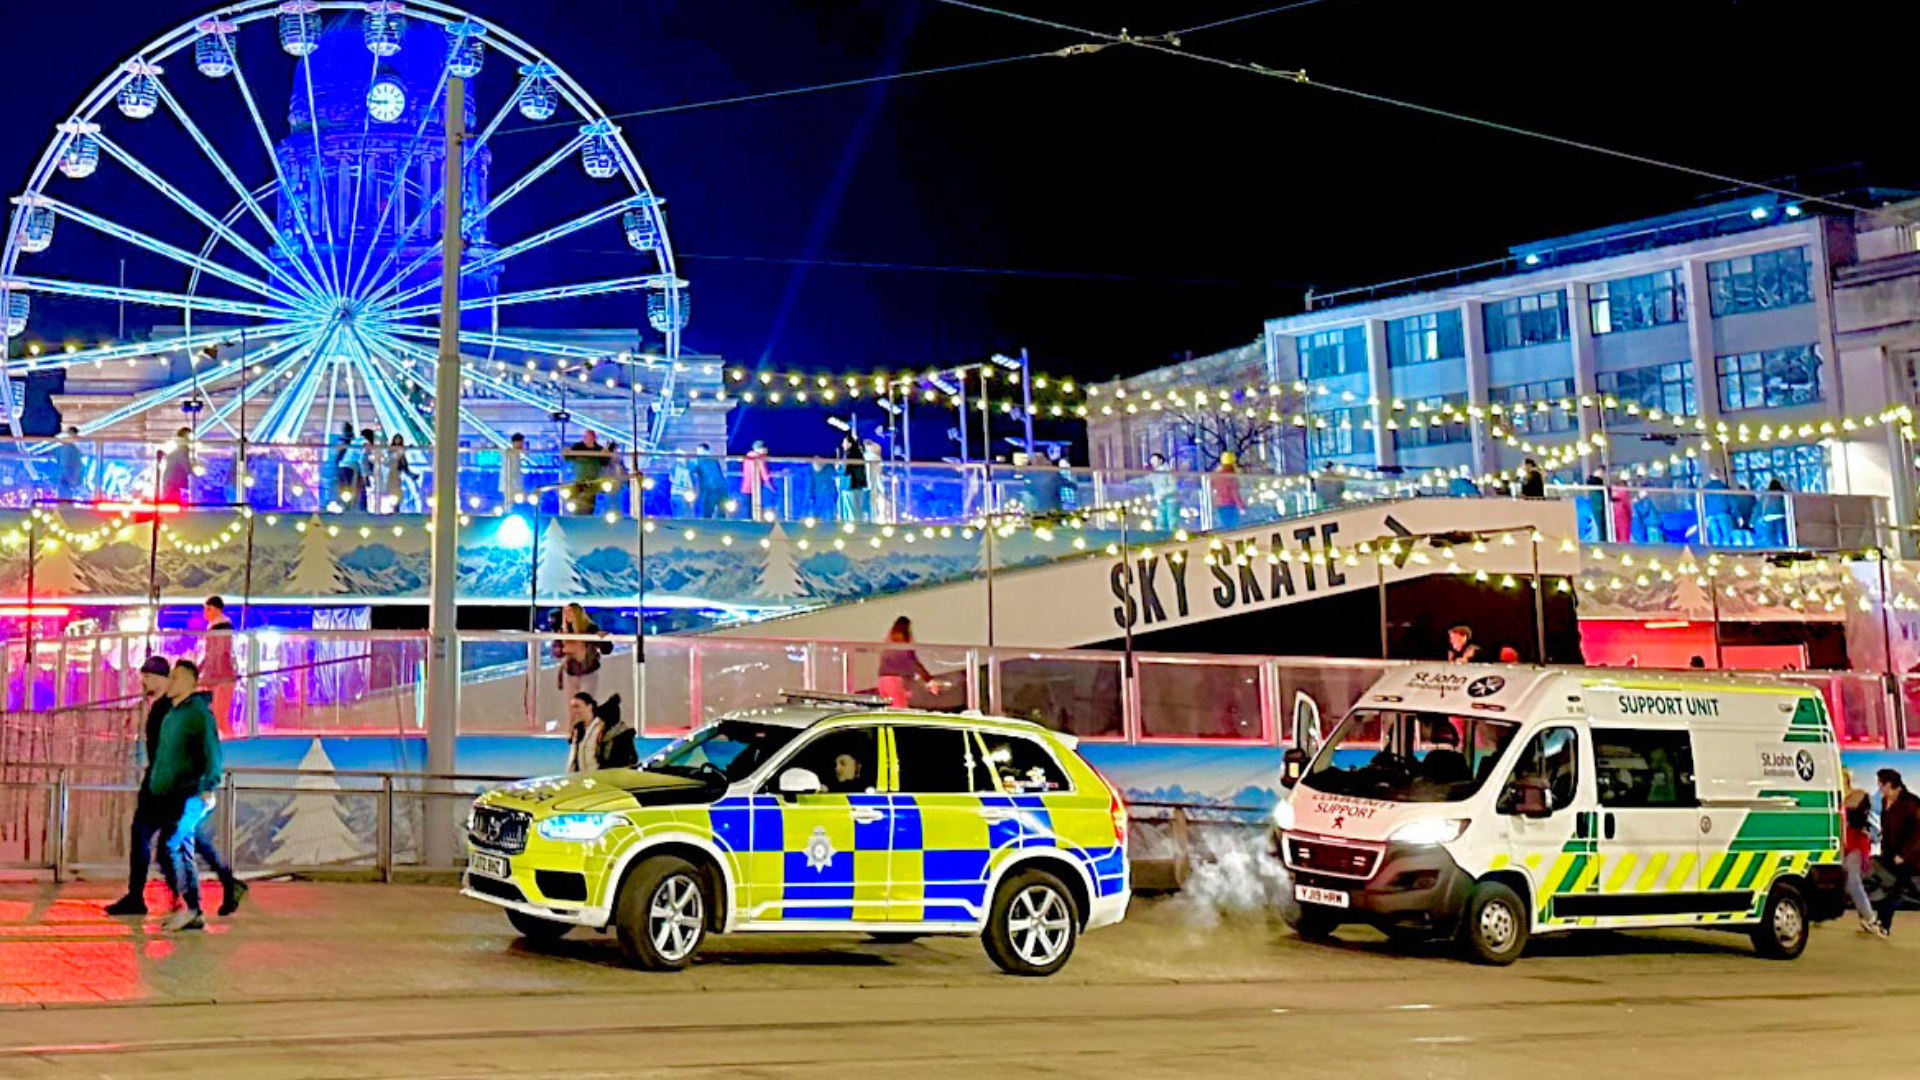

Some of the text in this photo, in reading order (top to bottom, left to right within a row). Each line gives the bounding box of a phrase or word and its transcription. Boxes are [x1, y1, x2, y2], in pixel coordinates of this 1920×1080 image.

[1111, 522, 1345, 629] SKY SKATE
[1429, 673, 1468, 685] John
[1619, 695, 1719, 716] SUPPORT UNIT
[1314, 802, 1378, 820] SUPPORT
